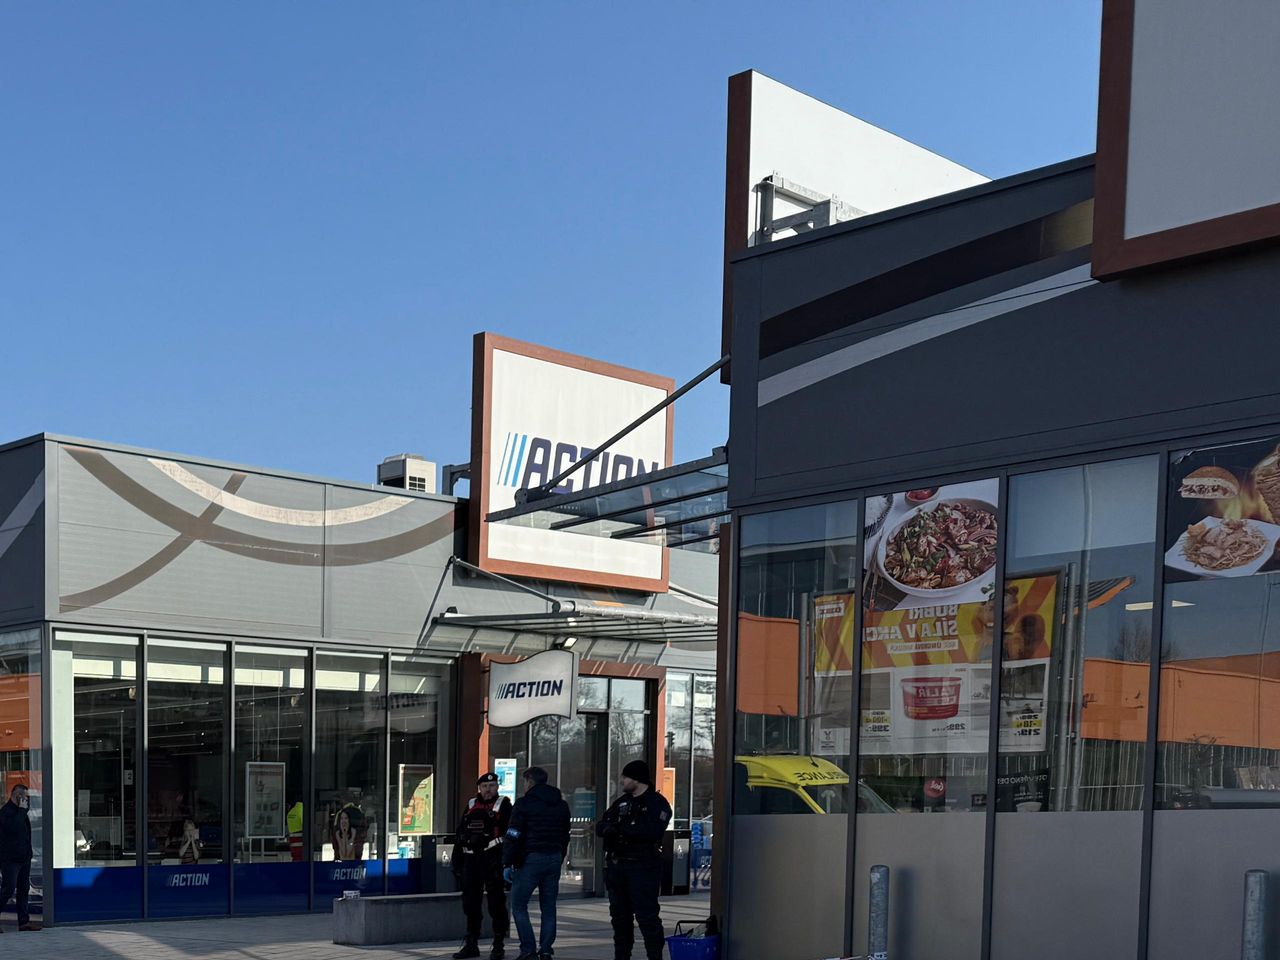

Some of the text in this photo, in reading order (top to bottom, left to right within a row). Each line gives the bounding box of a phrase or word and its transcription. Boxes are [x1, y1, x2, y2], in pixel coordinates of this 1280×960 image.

[520, 436, 659, 495] ACTIO
[504, 679, 564, 699] ACTION
[172, 872, 210, 887] ACTION
[333, 867, 367, 881] ACTION
